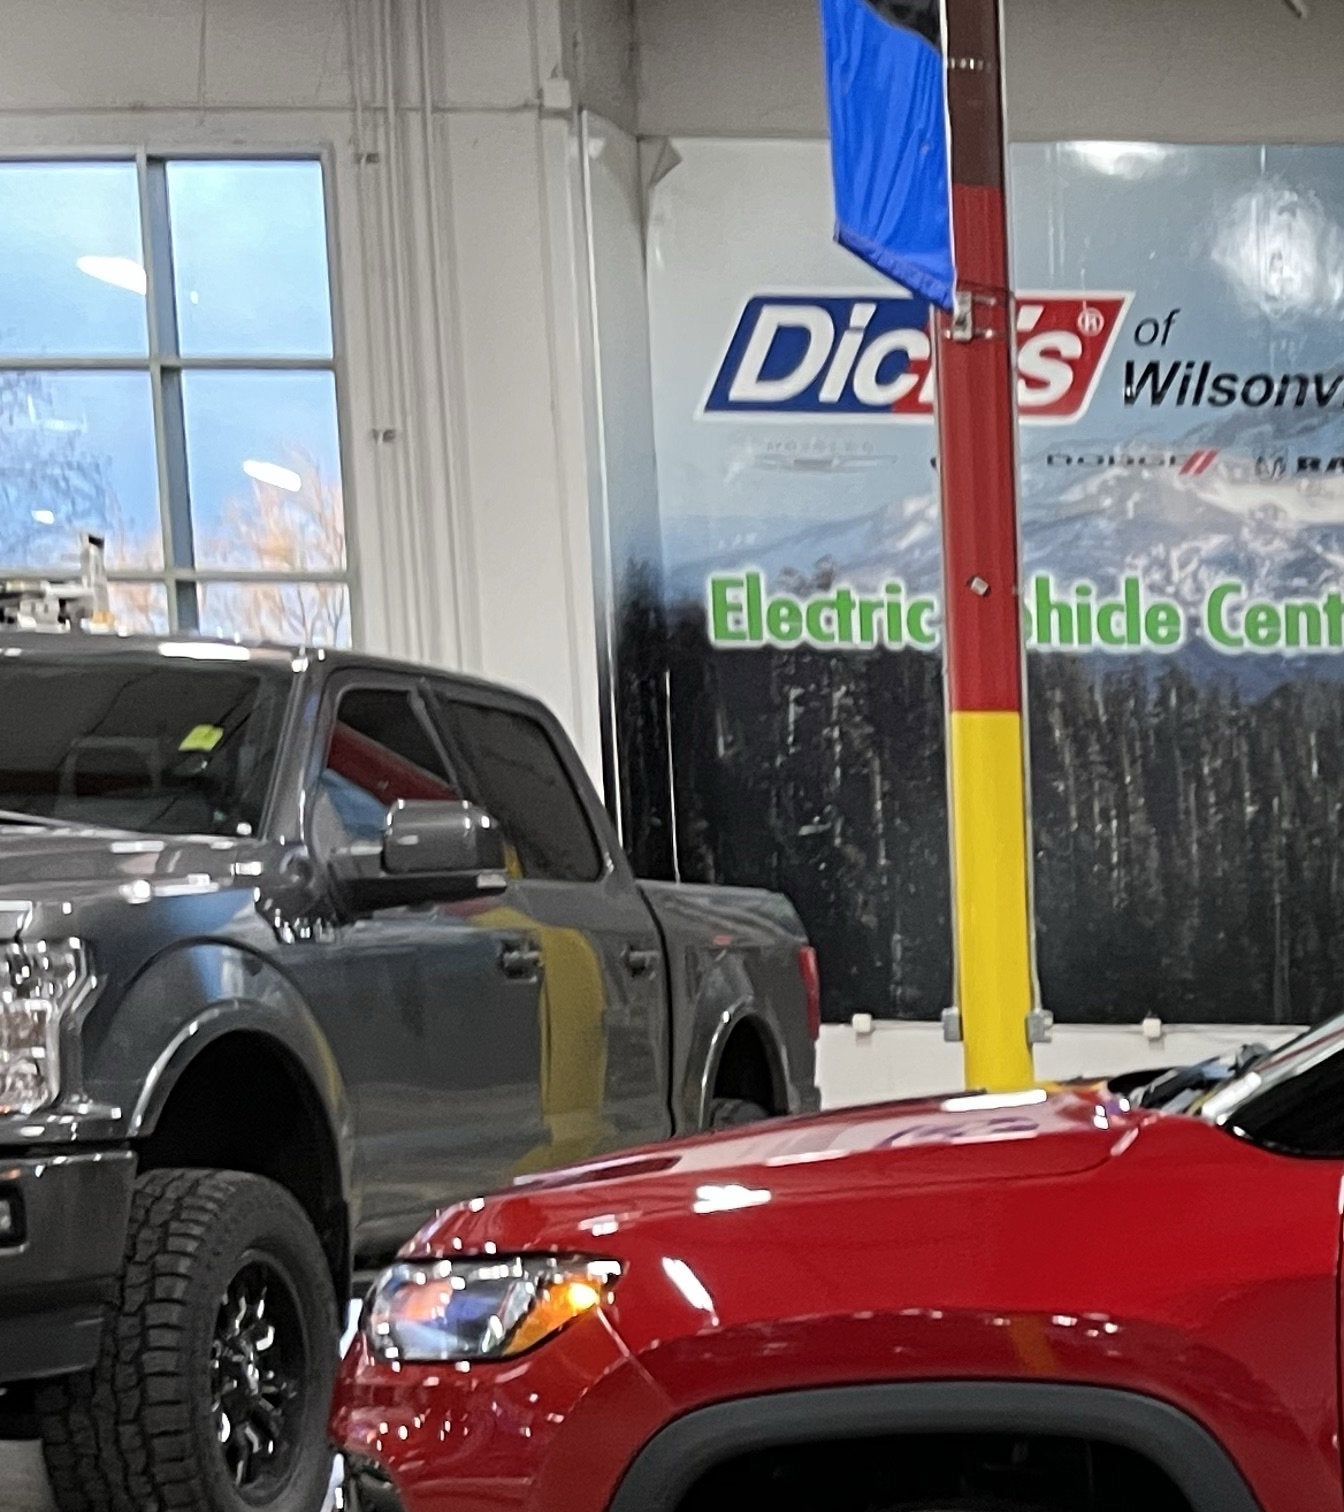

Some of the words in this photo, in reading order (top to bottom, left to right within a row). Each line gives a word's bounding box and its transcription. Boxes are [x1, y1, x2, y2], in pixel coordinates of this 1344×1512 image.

[728, 302, 1084, 406] Dic's
[1133, 298, 1181, 347] of
[711, 572, 937, 643] Electric
